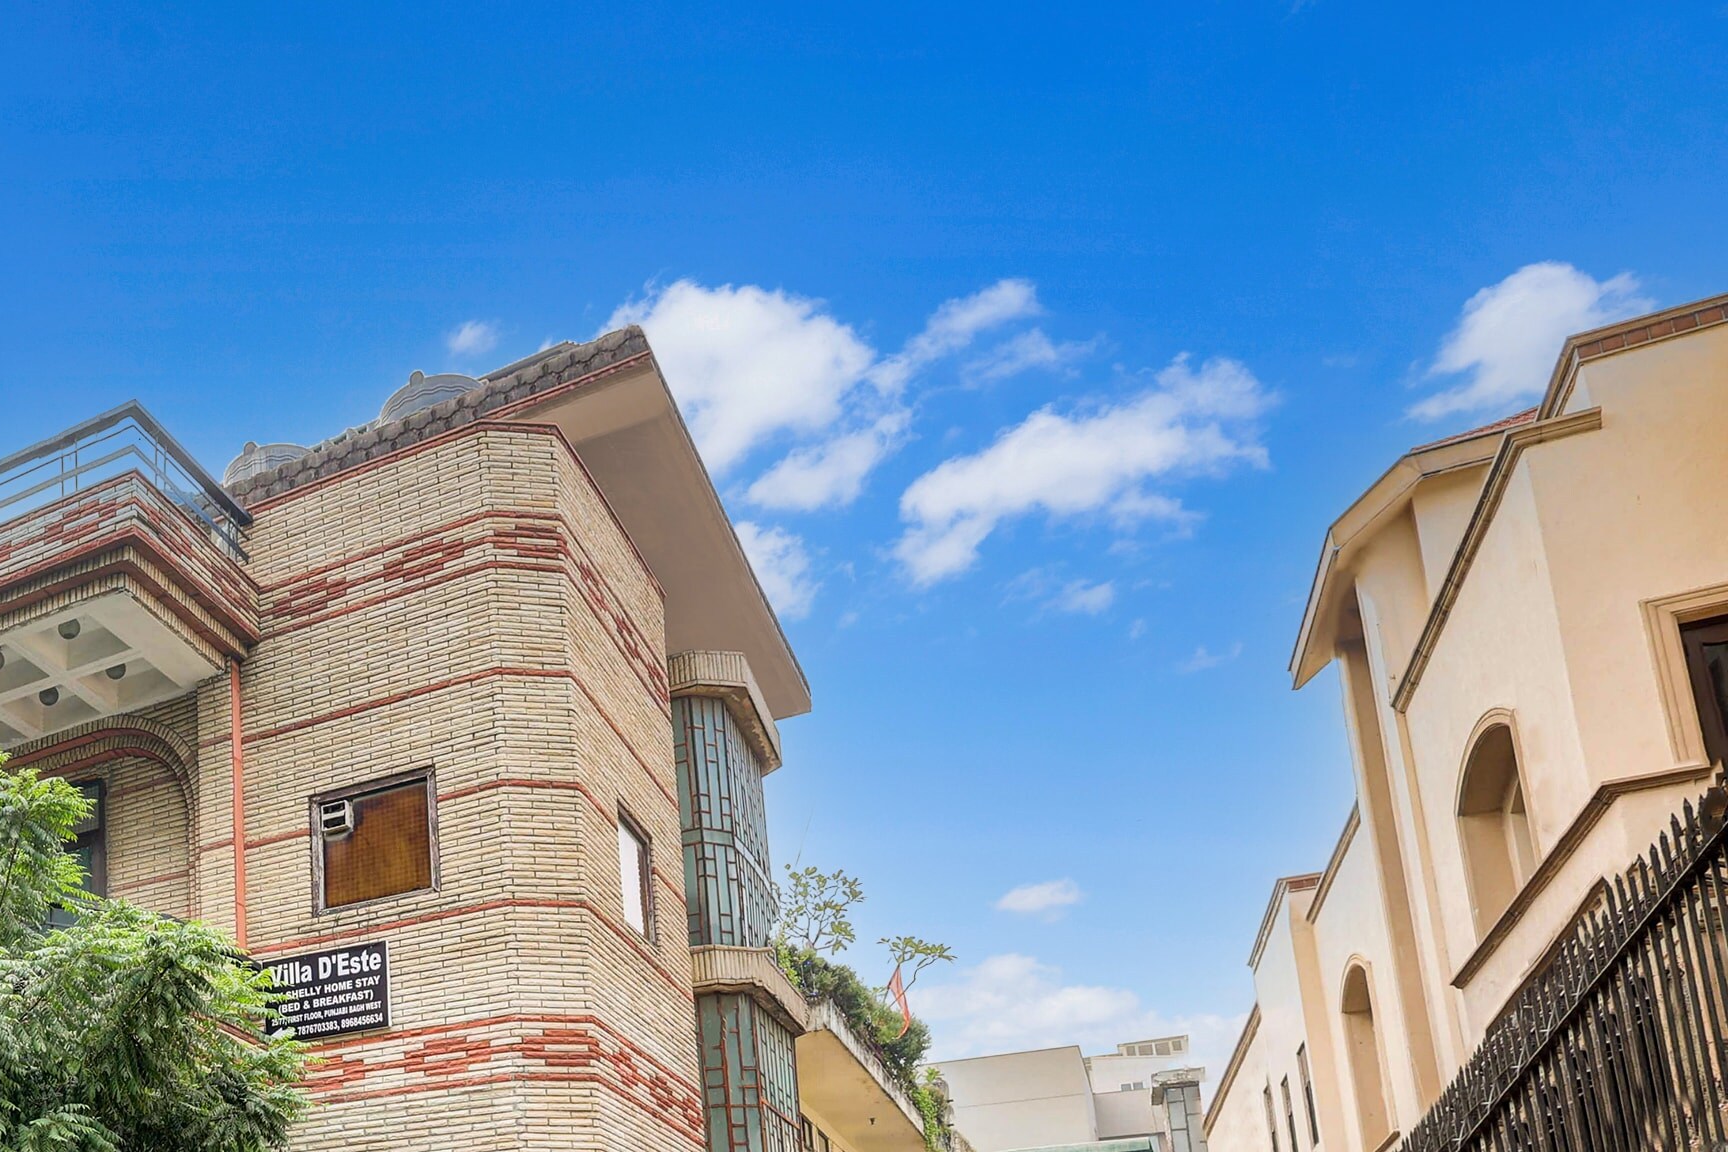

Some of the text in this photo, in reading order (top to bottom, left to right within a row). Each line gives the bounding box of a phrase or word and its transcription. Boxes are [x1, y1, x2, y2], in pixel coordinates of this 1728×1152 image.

[269, 949, 382, 988] Villa D'Este
[285, 985, 322, 999] SHELLY
[324, 980, 353, 994] HOME
[355, 974, 381, 988] STAY
[278, 990, 374, 1016] (BED & BREAKFAST)
[287, 1014, 303, 1024] FIRST
[303, 1011, 324, 1022] FLOOR,
[324, 1006, 348, 1018] PUNJABI
[348, 1003, 365, 1014] BAGH
[365, 1000, 382, 1011] WEST
